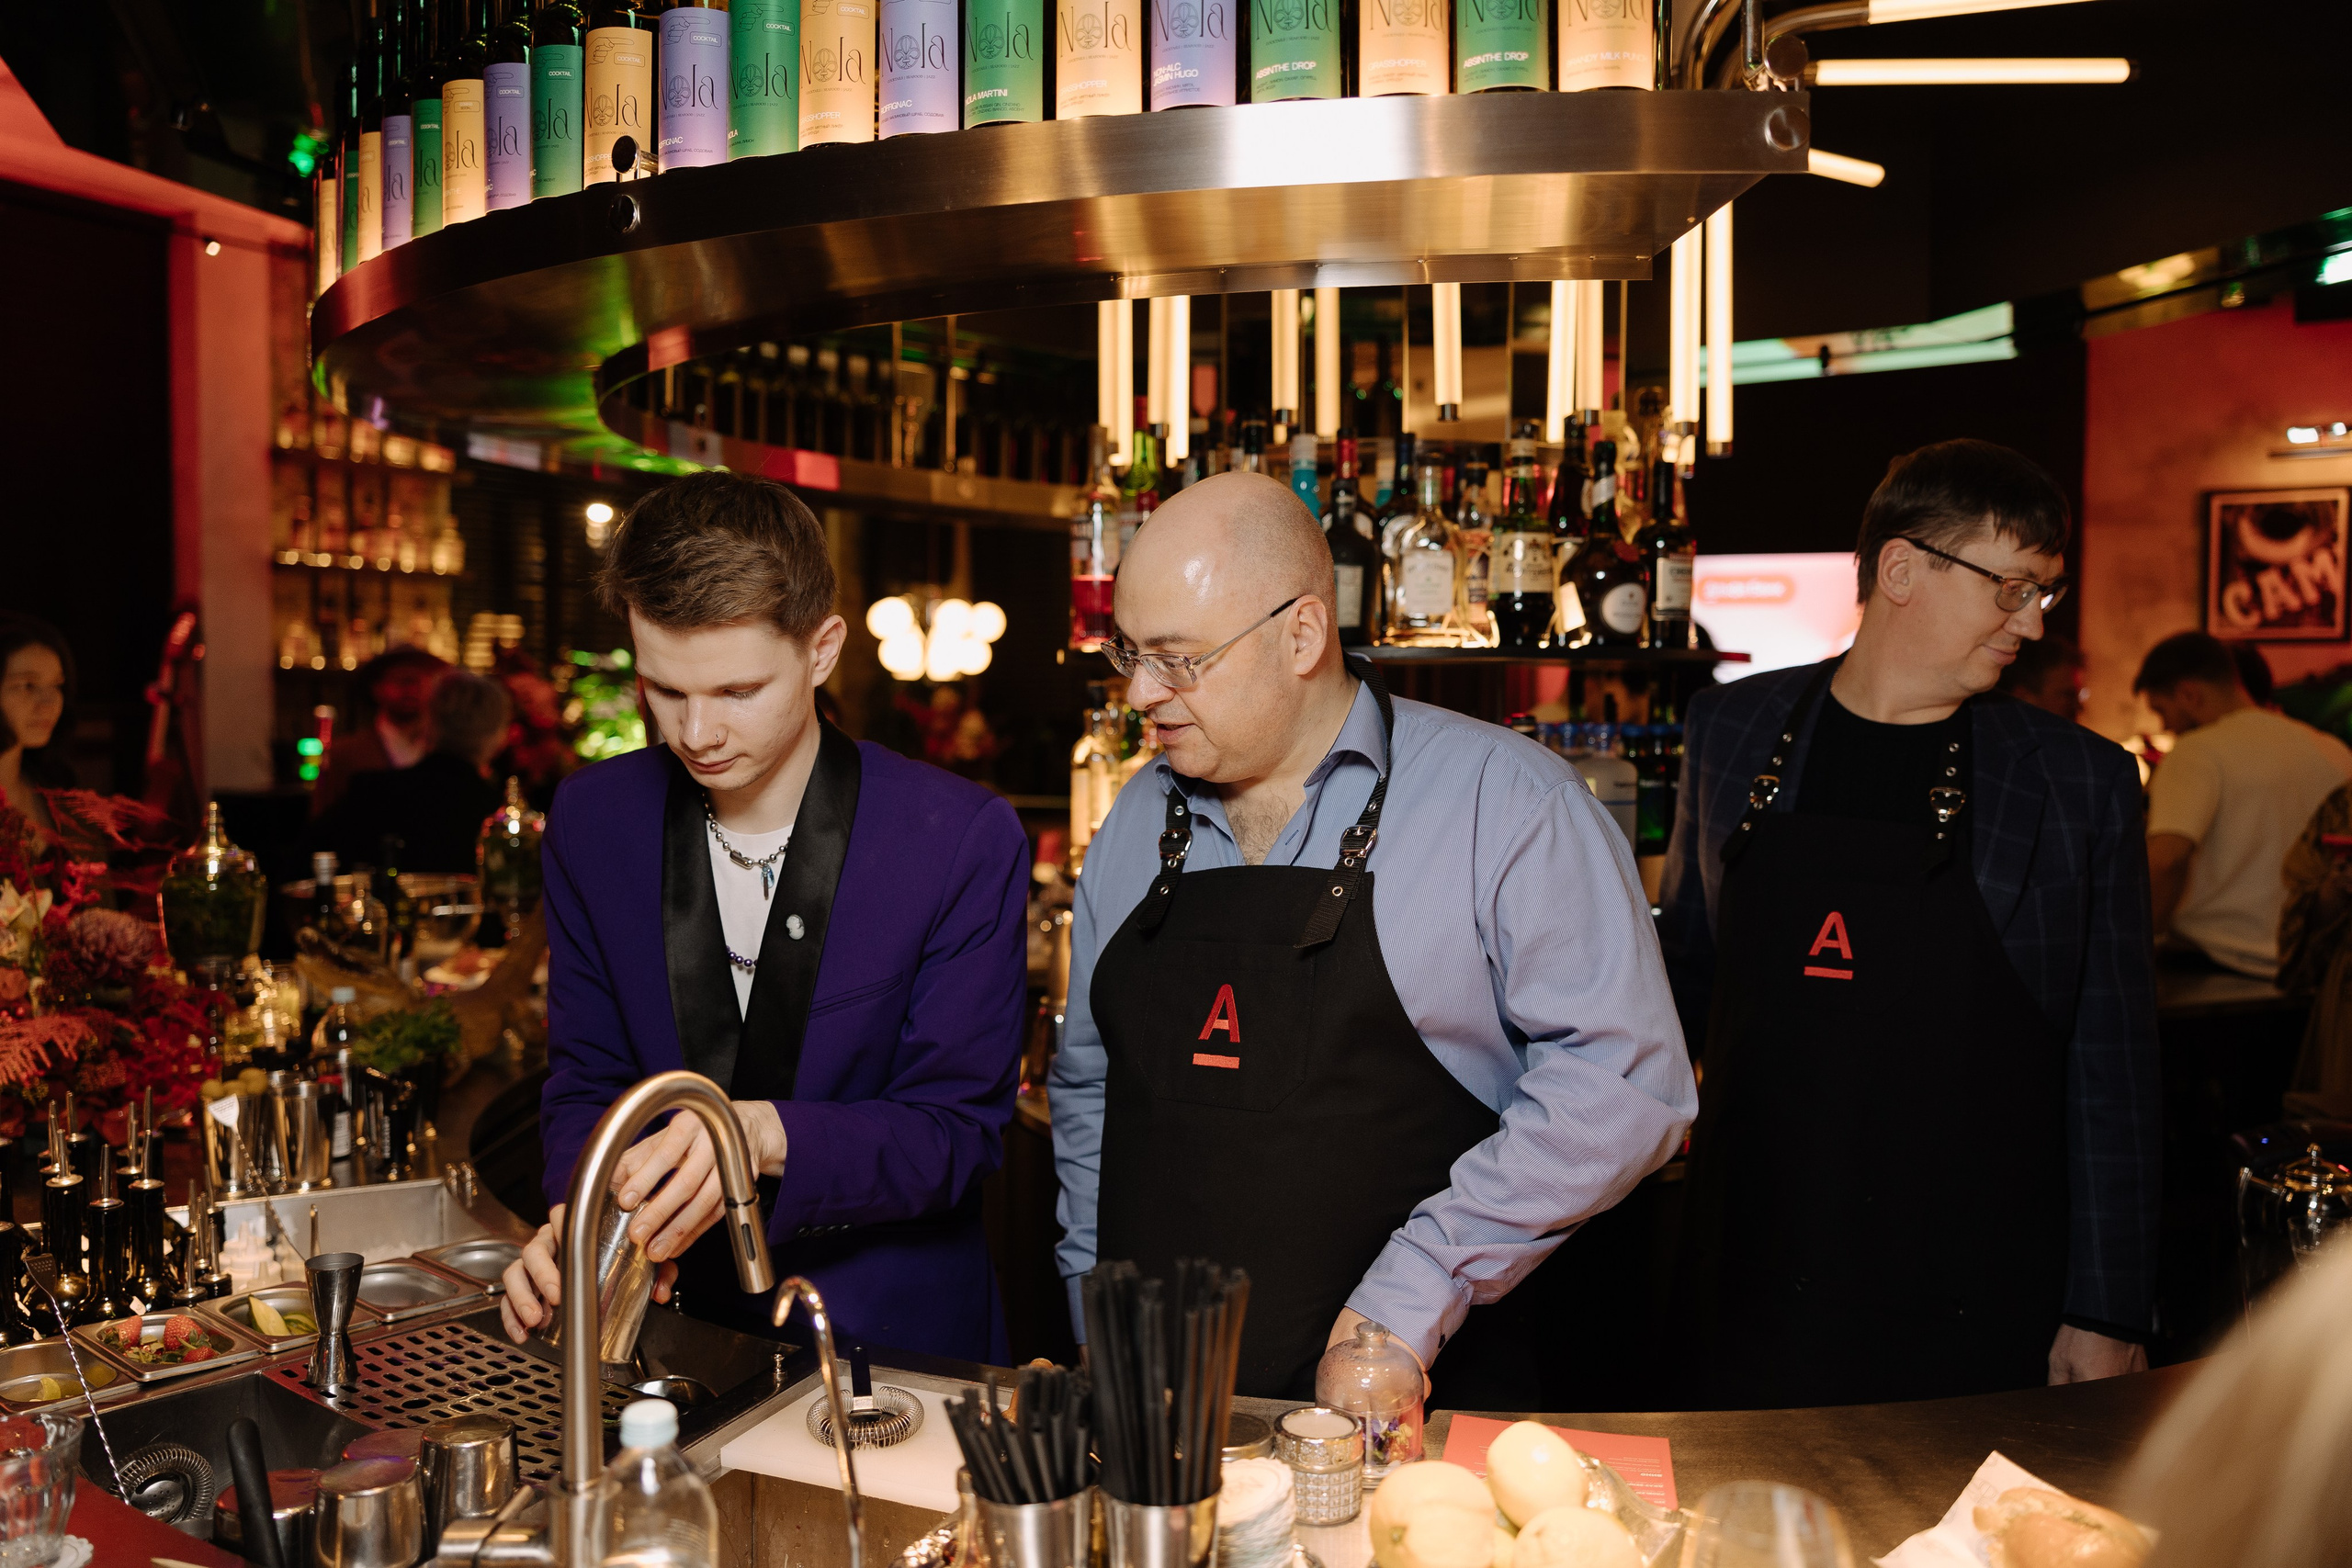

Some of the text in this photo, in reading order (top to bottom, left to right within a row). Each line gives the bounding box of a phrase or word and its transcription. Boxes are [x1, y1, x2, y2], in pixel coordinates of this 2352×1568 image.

[840, 6, 865, 15] COCKTAIL
[766, 23, 791, 31] COCKTAIL
[1155, 0, 1227, 47] Nola
[1256, 0, 1331, 40] Nola
[1060, 1, 1132, 58] Nola
[693, 35, 718, 43] COCKTAIL
[967, 12, 1034, 68] Nola
[881, 23, 949, 77] Nola
[1600, 51, 1620, 61] MILK
[801, 37, 865, 89] Nola
[1368, 58, 1427, 72] GRASSHOPPER
[1464, 51, 1529, 68] ABSINTHE DROP
[729, 53, 791, 104] Nola
[1174, 69, 1199, 78] HUGO
[1255, 61, 1317, 80] ABSINTHE DROP
[978, 88, 1008, 99] MARTINI
